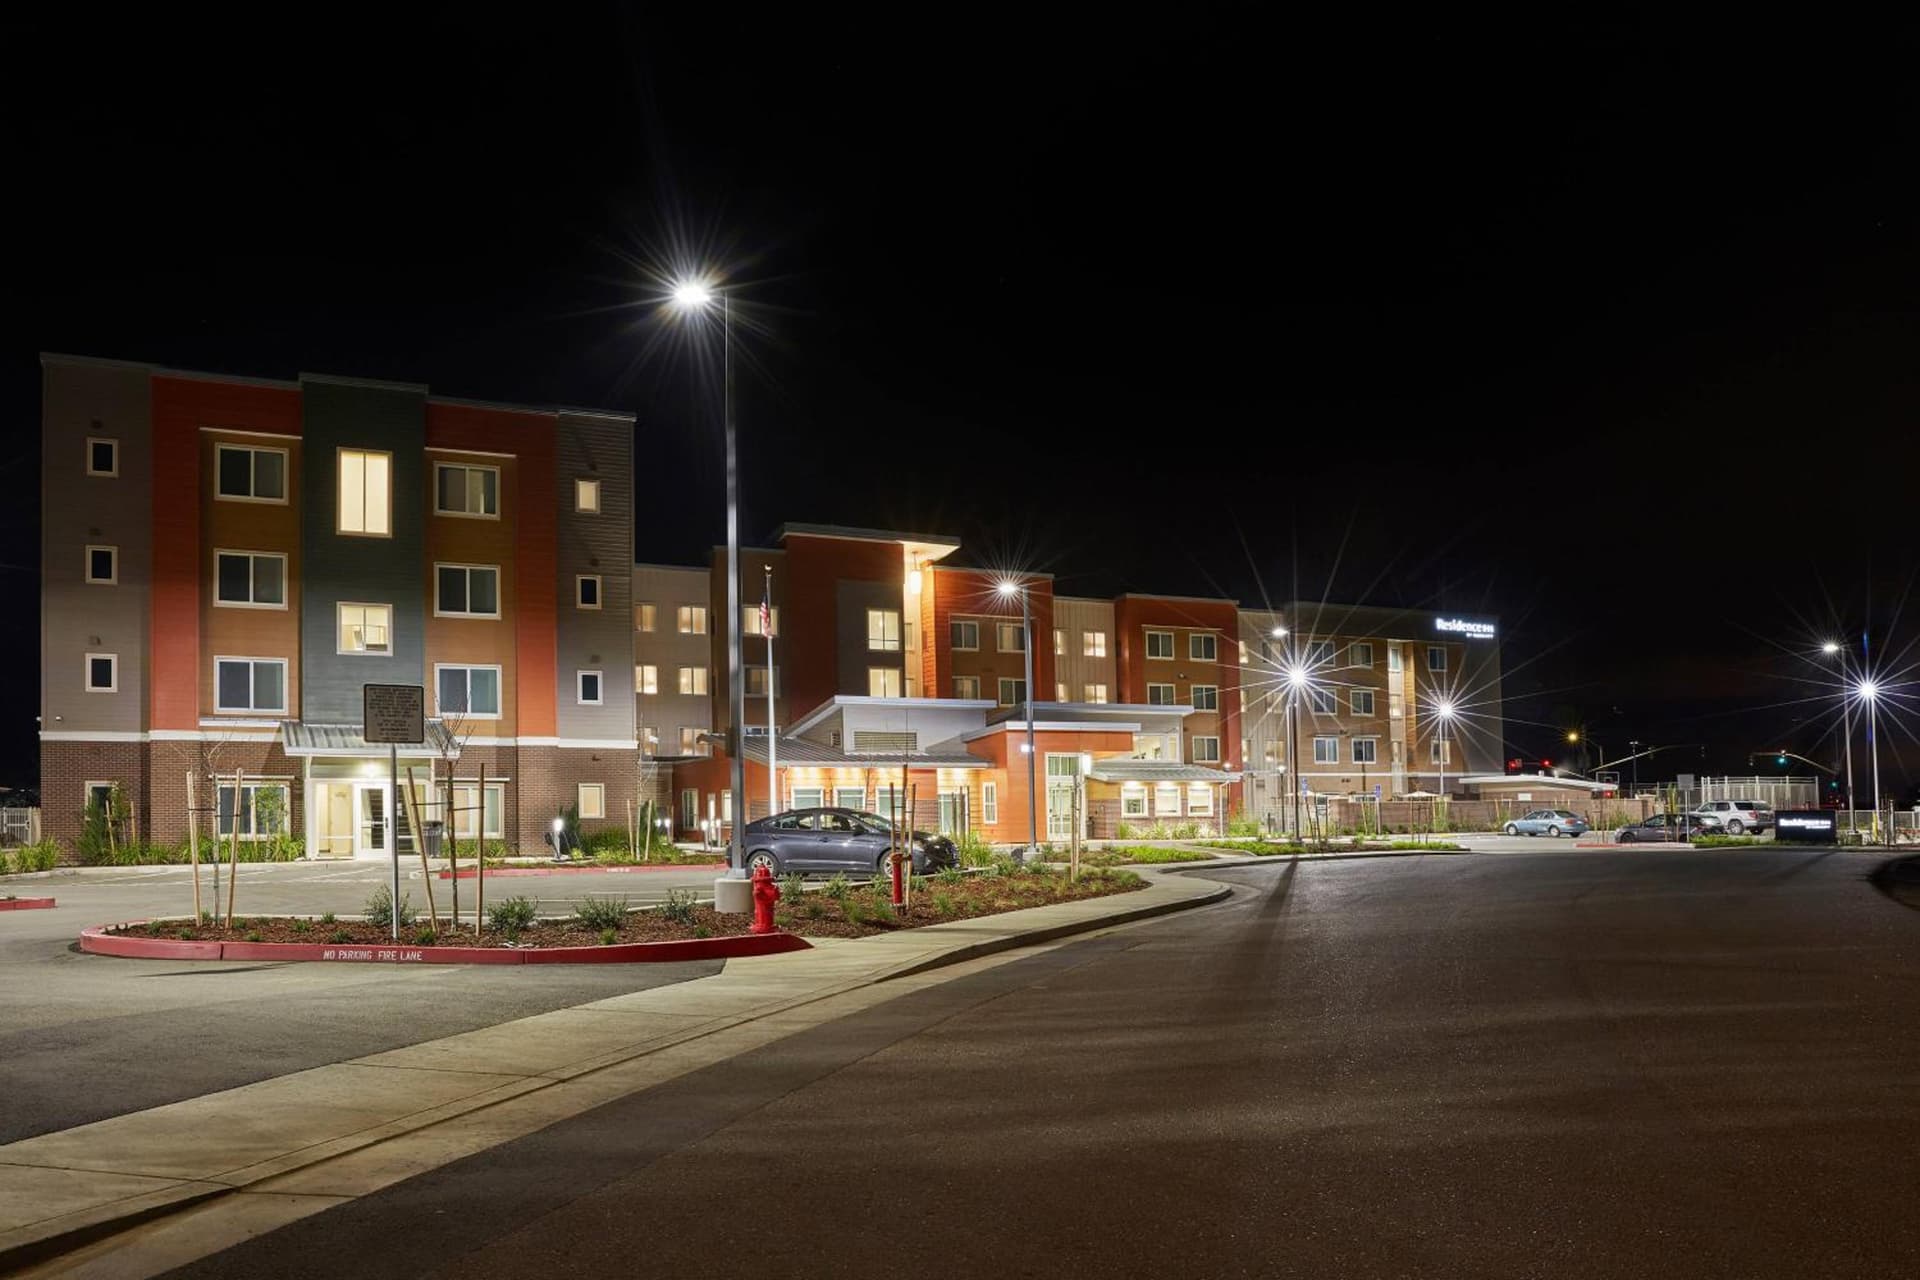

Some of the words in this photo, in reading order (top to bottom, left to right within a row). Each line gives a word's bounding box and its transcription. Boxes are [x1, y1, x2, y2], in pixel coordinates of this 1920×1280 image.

[1436, 617, 1482, 632] Residence
[323, 950, 336, 960] NO
[338, 950, 373, 960] PARKING
[378, 950, 398, 961] FIRE
[400, 951, 423, 961] LANE
